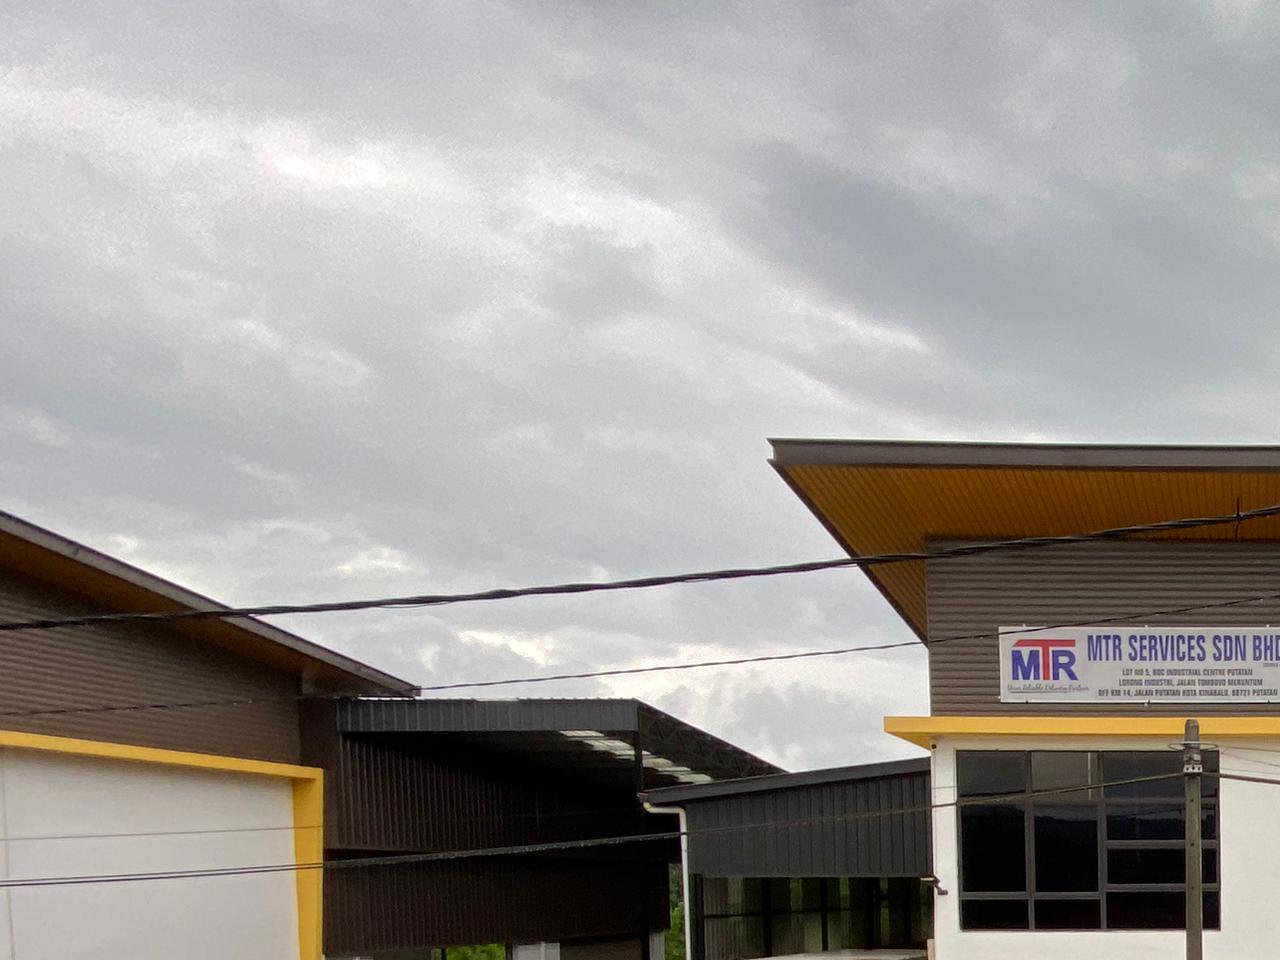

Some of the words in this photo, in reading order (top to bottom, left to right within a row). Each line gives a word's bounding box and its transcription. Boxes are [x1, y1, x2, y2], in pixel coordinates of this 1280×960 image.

[1011, 638, 1079, 681] MTR
[1086, 634, 1123, 662] MTR
[1128, 634, 1207, 662] SERVICES
[1212, 634, 1247, 662] SDN
